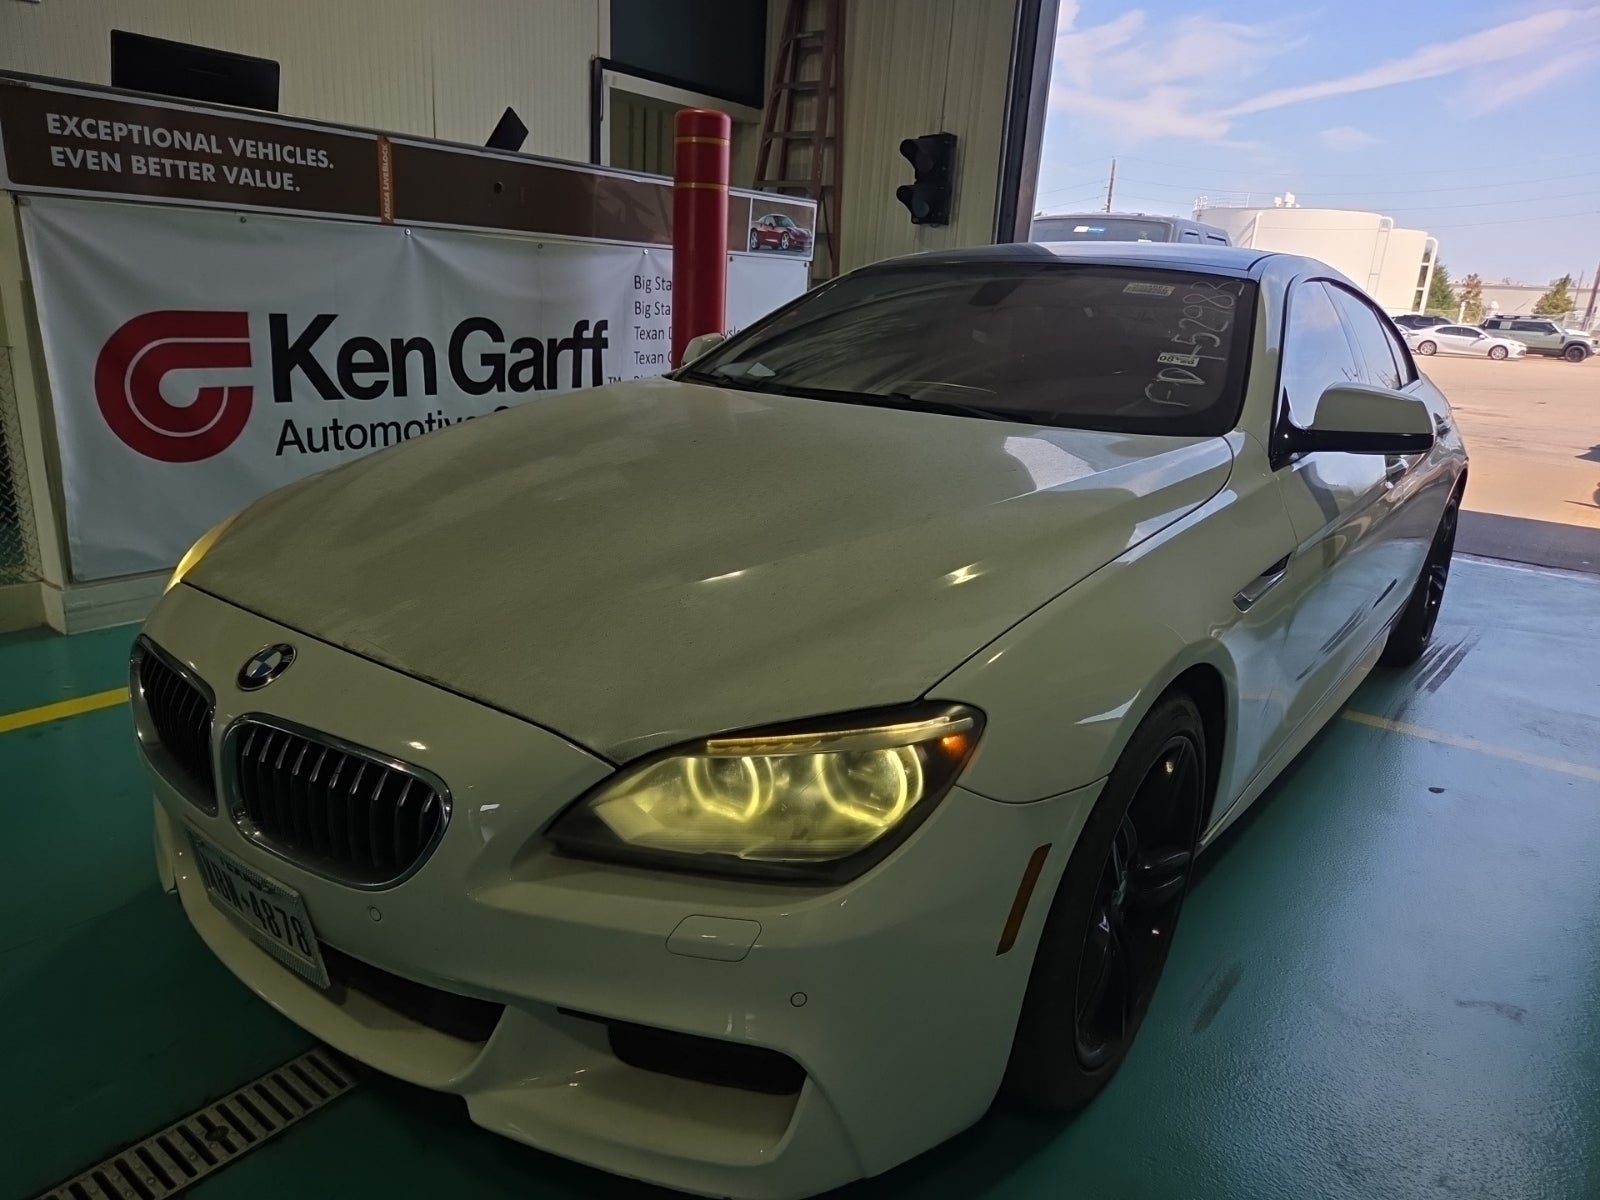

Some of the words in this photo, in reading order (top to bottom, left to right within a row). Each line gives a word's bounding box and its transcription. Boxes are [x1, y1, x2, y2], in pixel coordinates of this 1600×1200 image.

[46, 113, 222, 154] EXCEPTIONAL
[228, 137, 334, 169] VEHICLES.
[50, 146, 121, 173] EVEN
[131, 155, 216, 183] BETTER
[222, 165, 301, 192] VALUE.
[634, 275, 651, 294] Big
[654, 276, 672, 291] Sta
[634, 301, 651, 318] Big
[654, 302, 671, 316] Sta
[634, 326, 665, 341] Texan
[268, 313, 437, 403] Ken
[448, 316, 609, 396] Garff
[634, 351, 664, 365] Texan
[276, 410, 477, 456] Automoti
